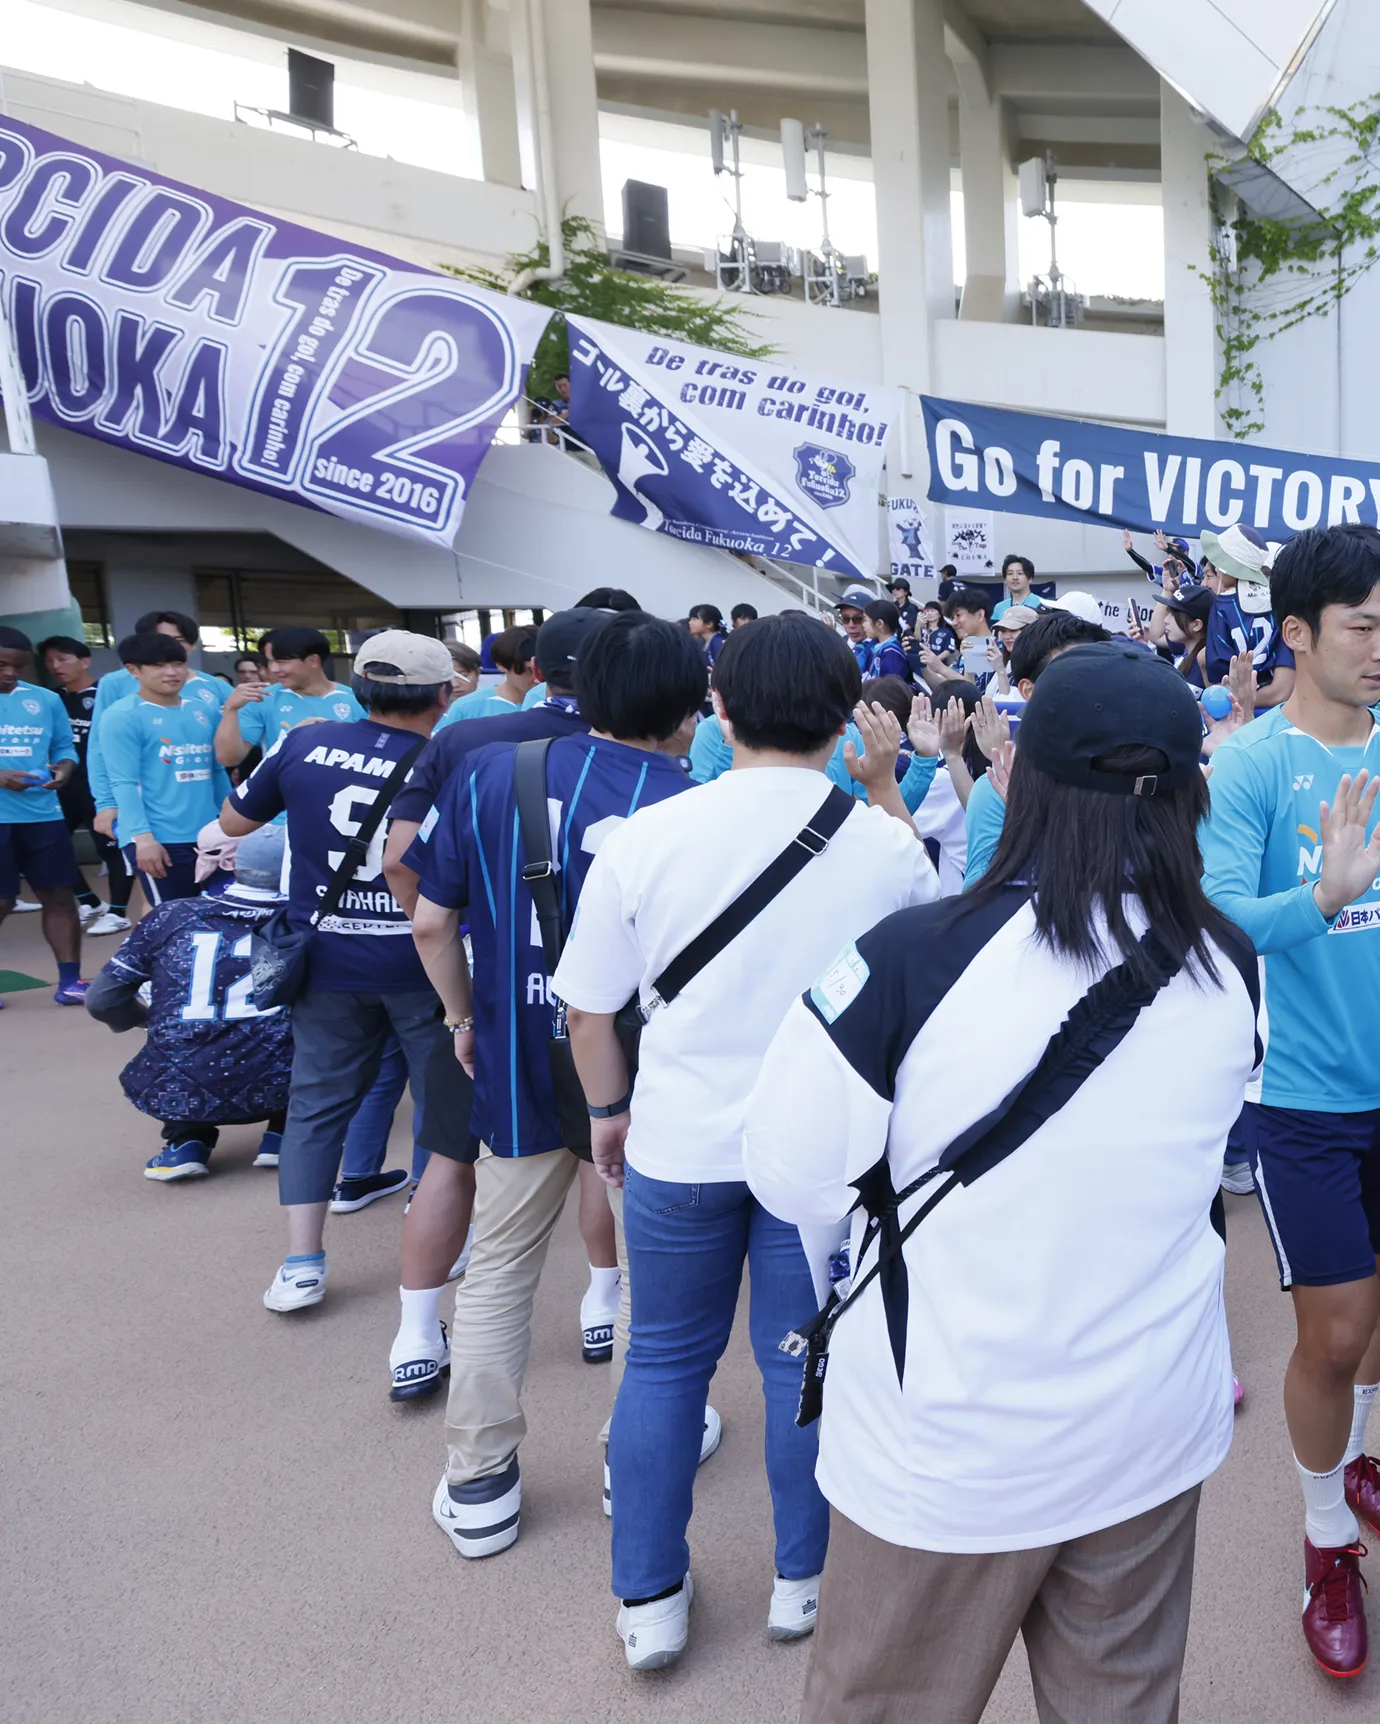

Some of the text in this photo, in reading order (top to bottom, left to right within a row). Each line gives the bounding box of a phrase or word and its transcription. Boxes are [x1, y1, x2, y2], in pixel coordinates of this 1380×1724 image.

[340, 267, 364, 286] De
[319, 284, 350, 317] tras
[308, 310, 335, 337] do
[277, 360, 304, 400] com
[645, 346, 870, 414] De tras do gol,
[261, 398, 292, 467] carinho!
[680, 382, 888, 447] com carinho!
[314, 456, 440, 514] since 2016
[935, 418, 1016, 496] Go
[1037, 439, 1125, 515] for
[705, 530, 765, 554] Fukuoka
[771, 542, 794, 558] 12
[891, 563, 934, 578] GATE
[1231, 616, 1273, 666] 12
